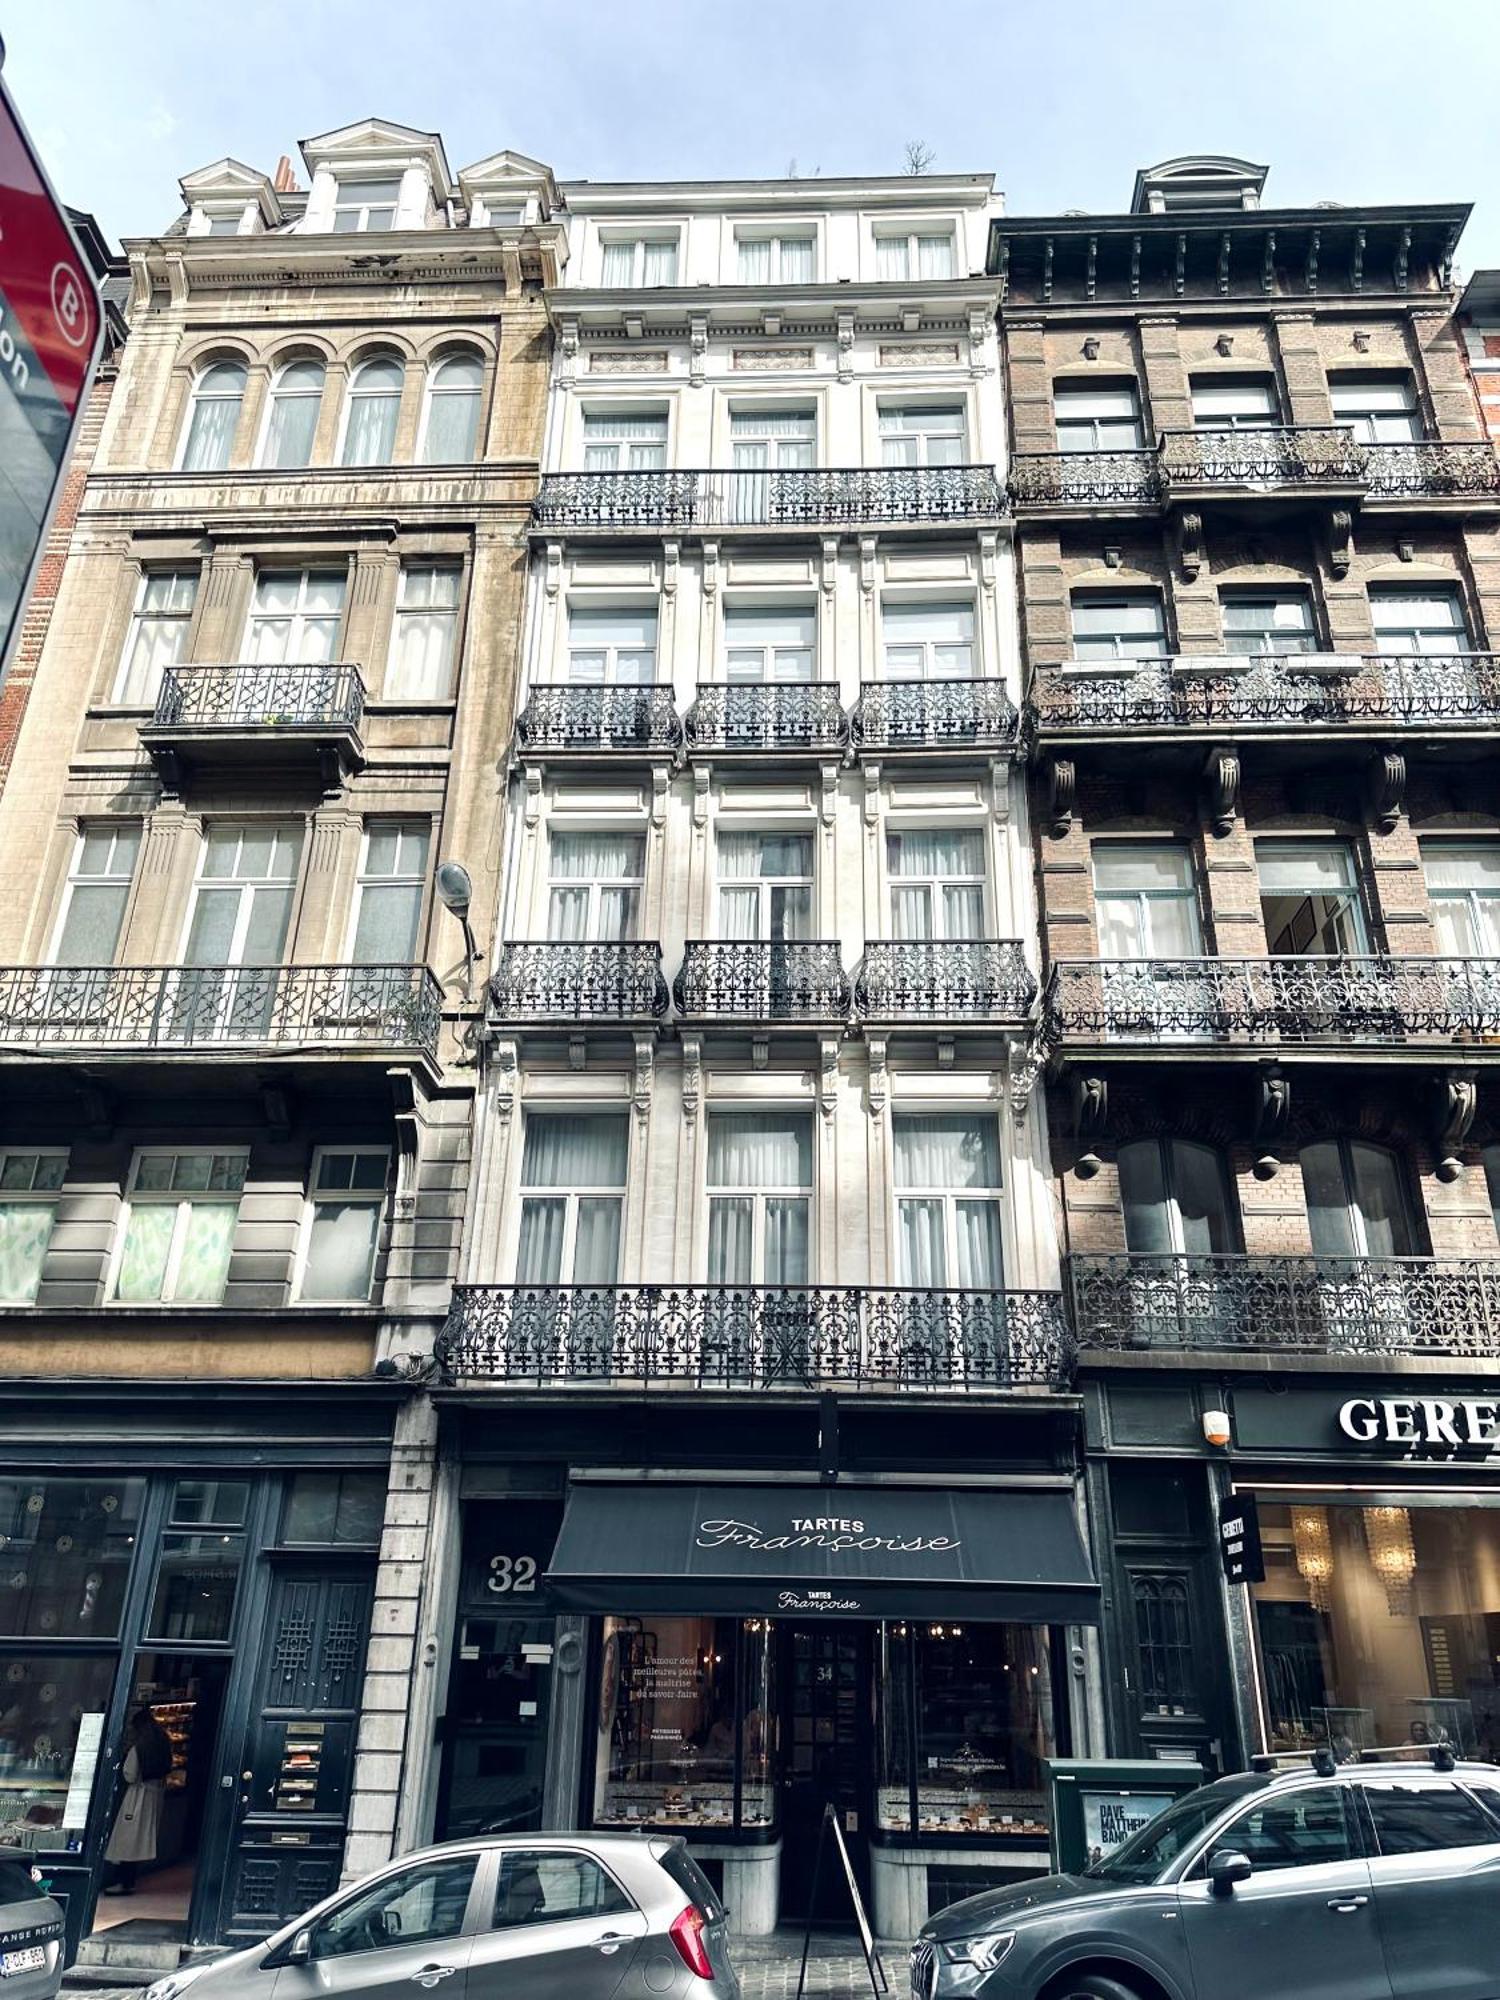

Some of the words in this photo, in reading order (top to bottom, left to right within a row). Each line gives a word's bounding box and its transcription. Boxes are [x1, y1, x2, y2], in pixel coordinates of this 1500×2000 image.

[791, 1518, 865, 1533] TARTES
[696, 1519, 961, 1552] Françoise
[488, 1555, 537, 1592] 32
[777, 1591, 861, 1611] Françoise
[807, 1591, 832, 1599] TARTES
[816, 1666, 833, 1681] 34
[1100, 1804, 1125, 1818] DAVE
[1102, 1830, 1128, 1844] BAND
